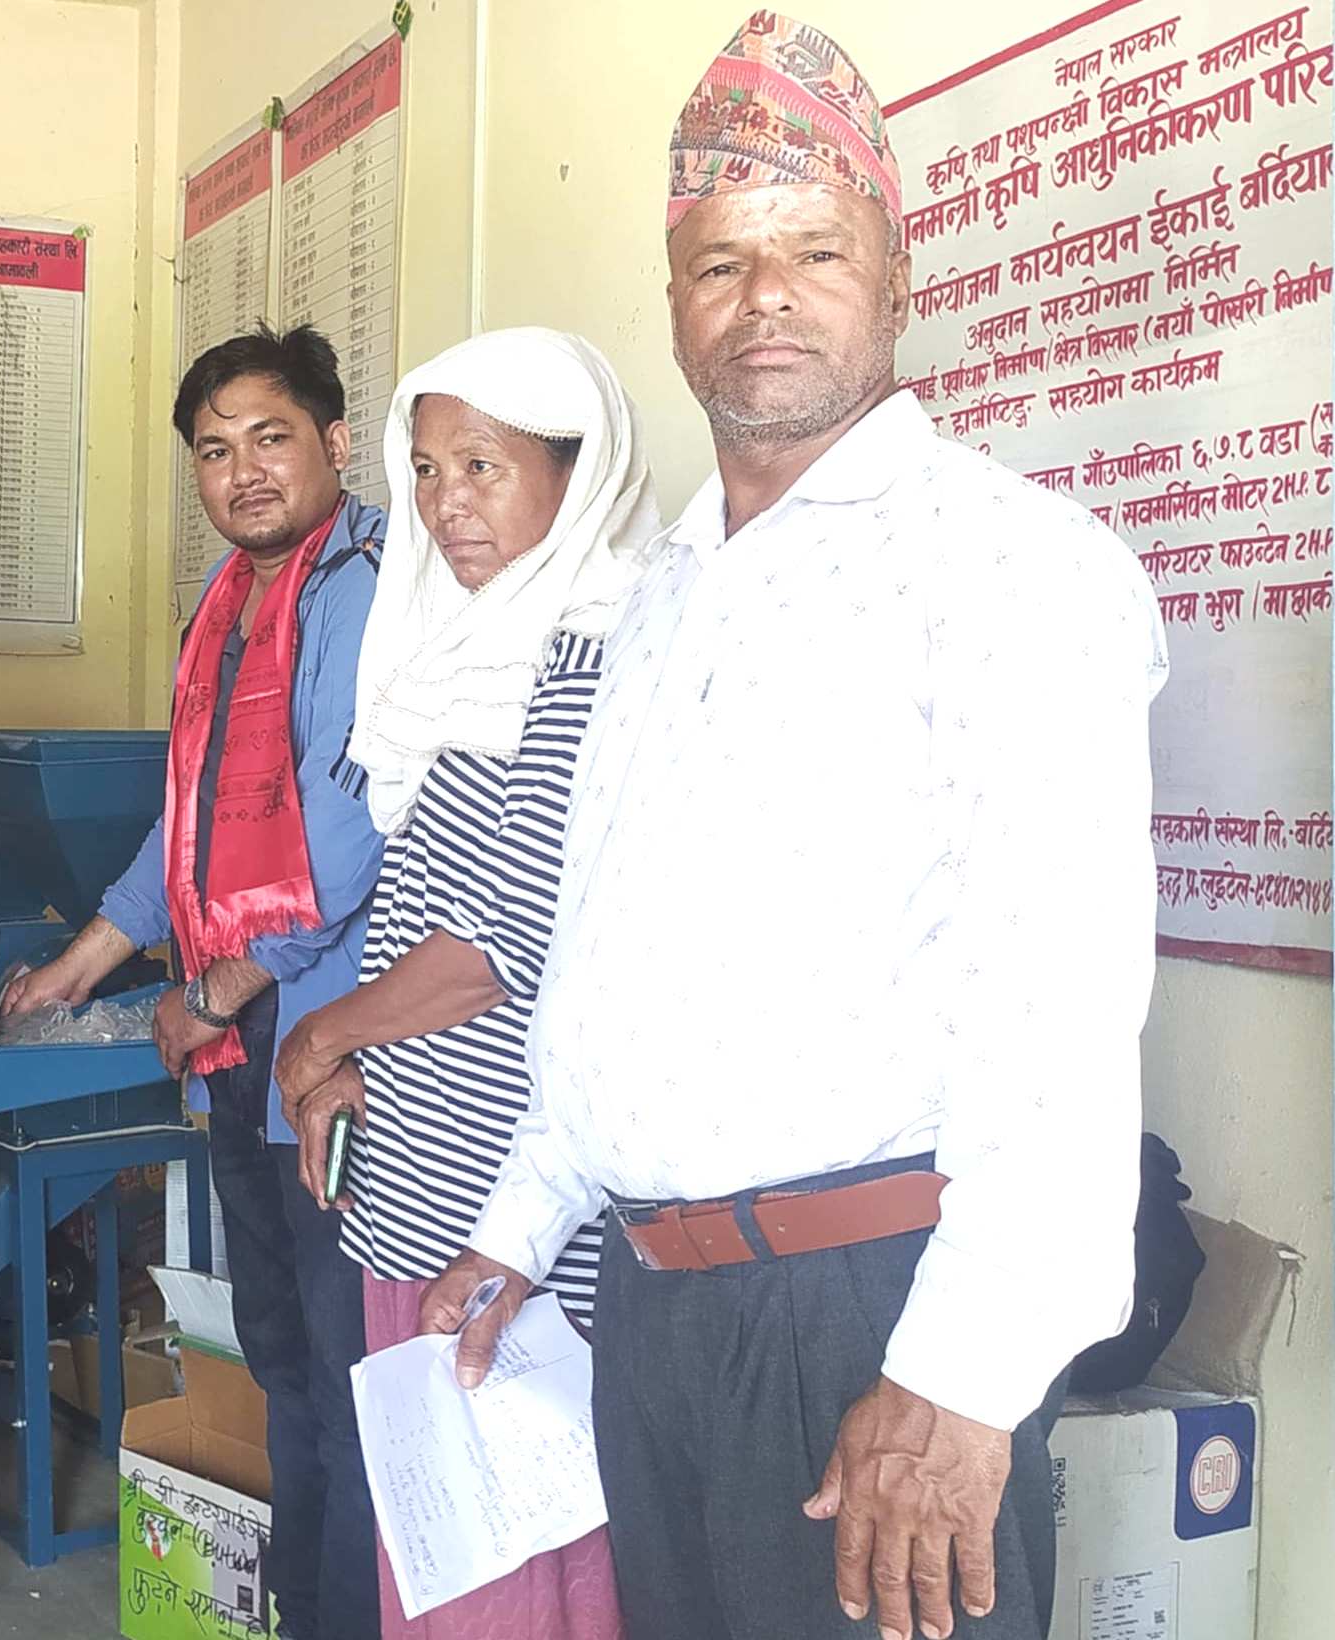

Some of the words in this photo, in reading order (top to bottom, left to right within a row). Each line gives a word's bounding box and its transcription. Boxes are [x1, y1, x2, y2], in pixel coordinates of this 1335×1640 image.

[1055, 50, 1101, 88] नेपाल
[1109, 16, 1180, 70] सरकार
[926, 146, 968, 195] कृषि
[971, 135, 1001, 173] तथा
[1098, 61, 1188, 122] विकास
[984, 156, 1041, 231] कृषि
[912, 264, 1002, 321] परियोजना
[965, 306, 1030, 353] अनुदान
[1041, 271, 1154, 329] सहयोगमा
[1164, 241, 1240, 295] निर्मित
[1049, 370, 1124, 419] सहयोग
[1132, 350, 1222, 396] कार्यक्रम
[1221, 473, 1268, 516] मोटर
[1215, 812, 1260, 848] संस्था
